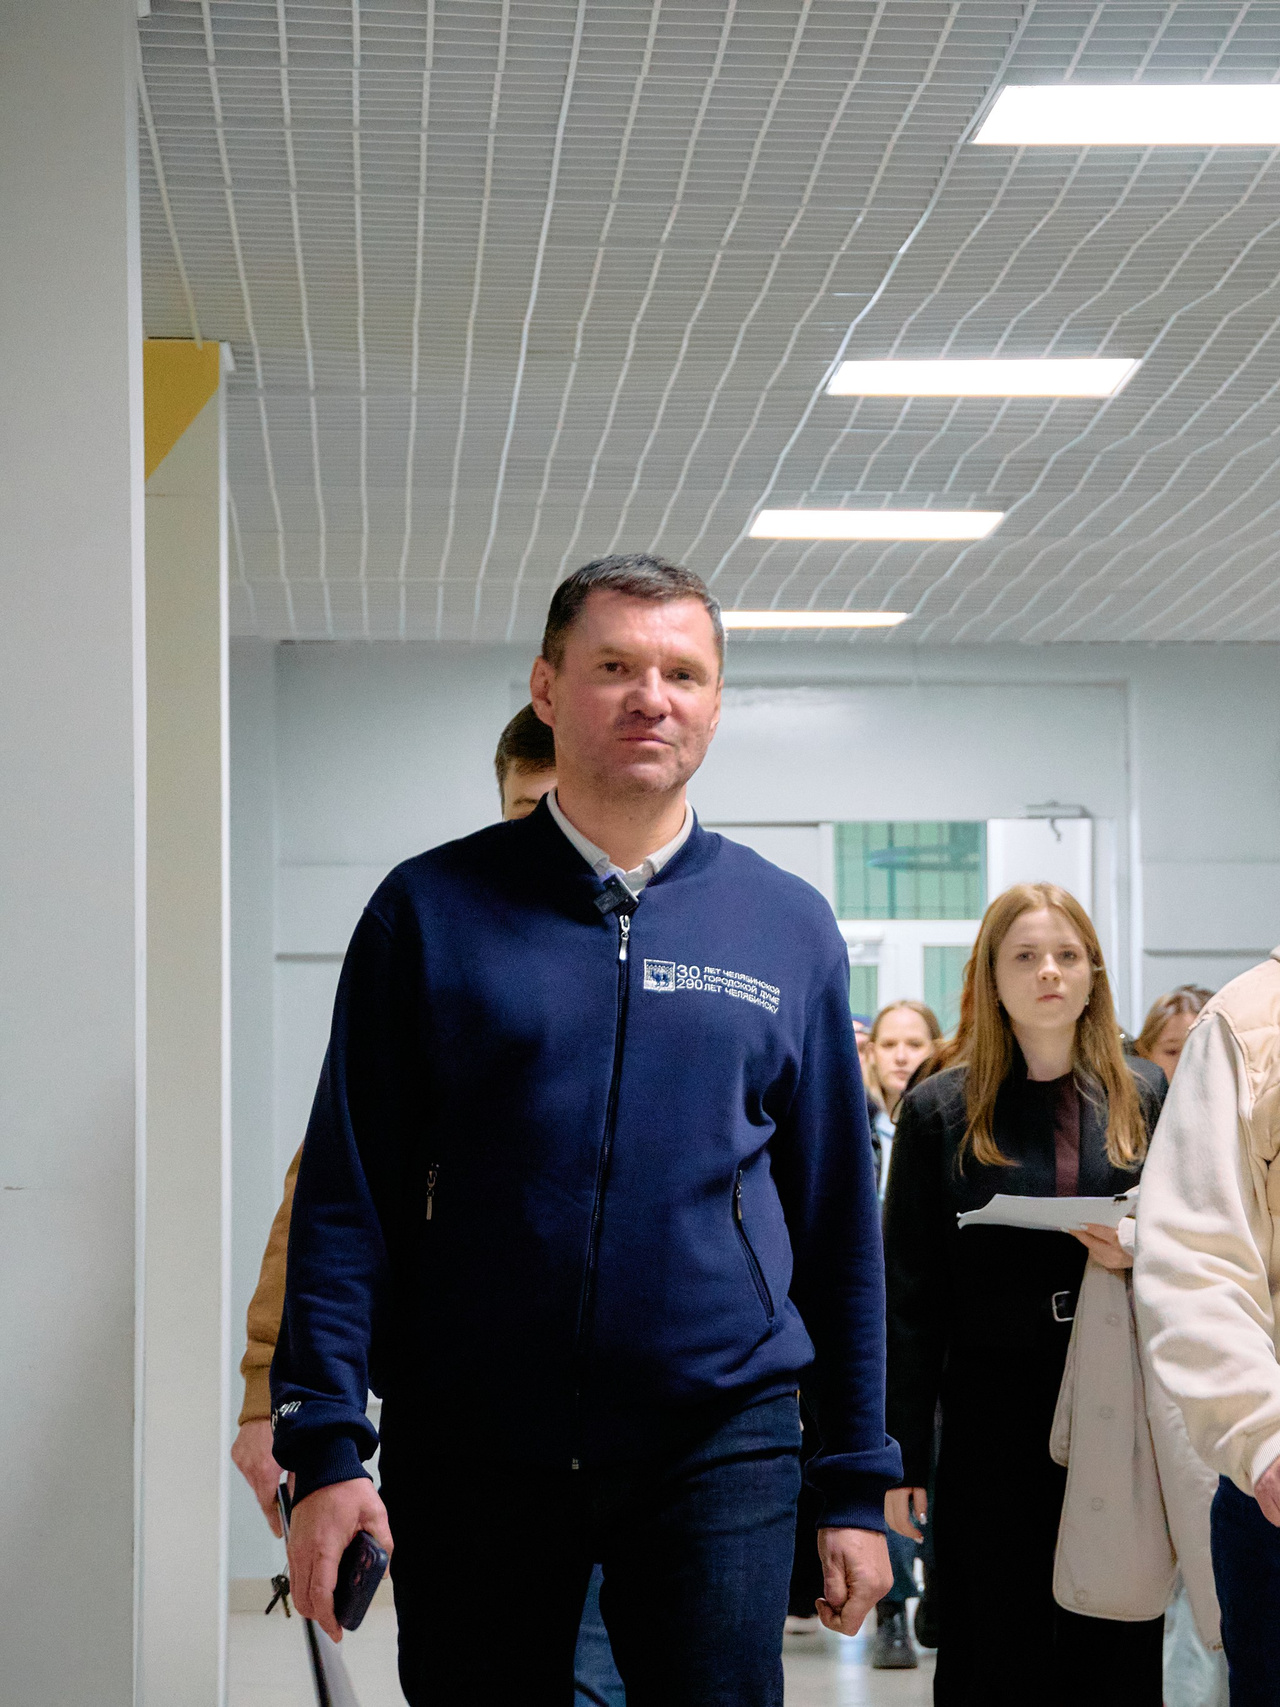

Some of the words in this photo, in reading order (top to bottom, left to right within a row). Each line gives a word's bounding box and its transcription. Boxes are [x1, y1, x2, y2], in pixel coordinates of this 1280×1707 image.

[676, 964, 700, 979] 30
[703, 966, 721, 975] ЛЕТ
[722, 969, 780, 995] ЧЕЛЯБИНСКОЙ
[703, 974, 757, 995] ГОРОДСКОЙ
[759, 989, 780, 1005] ДУМЕ
[676, 978, 703, 990] 290
[703, 982, 722, 993] ЛЕТ
[724, 987, 779, 1014] ЧЕЛЯБИНСКУ
